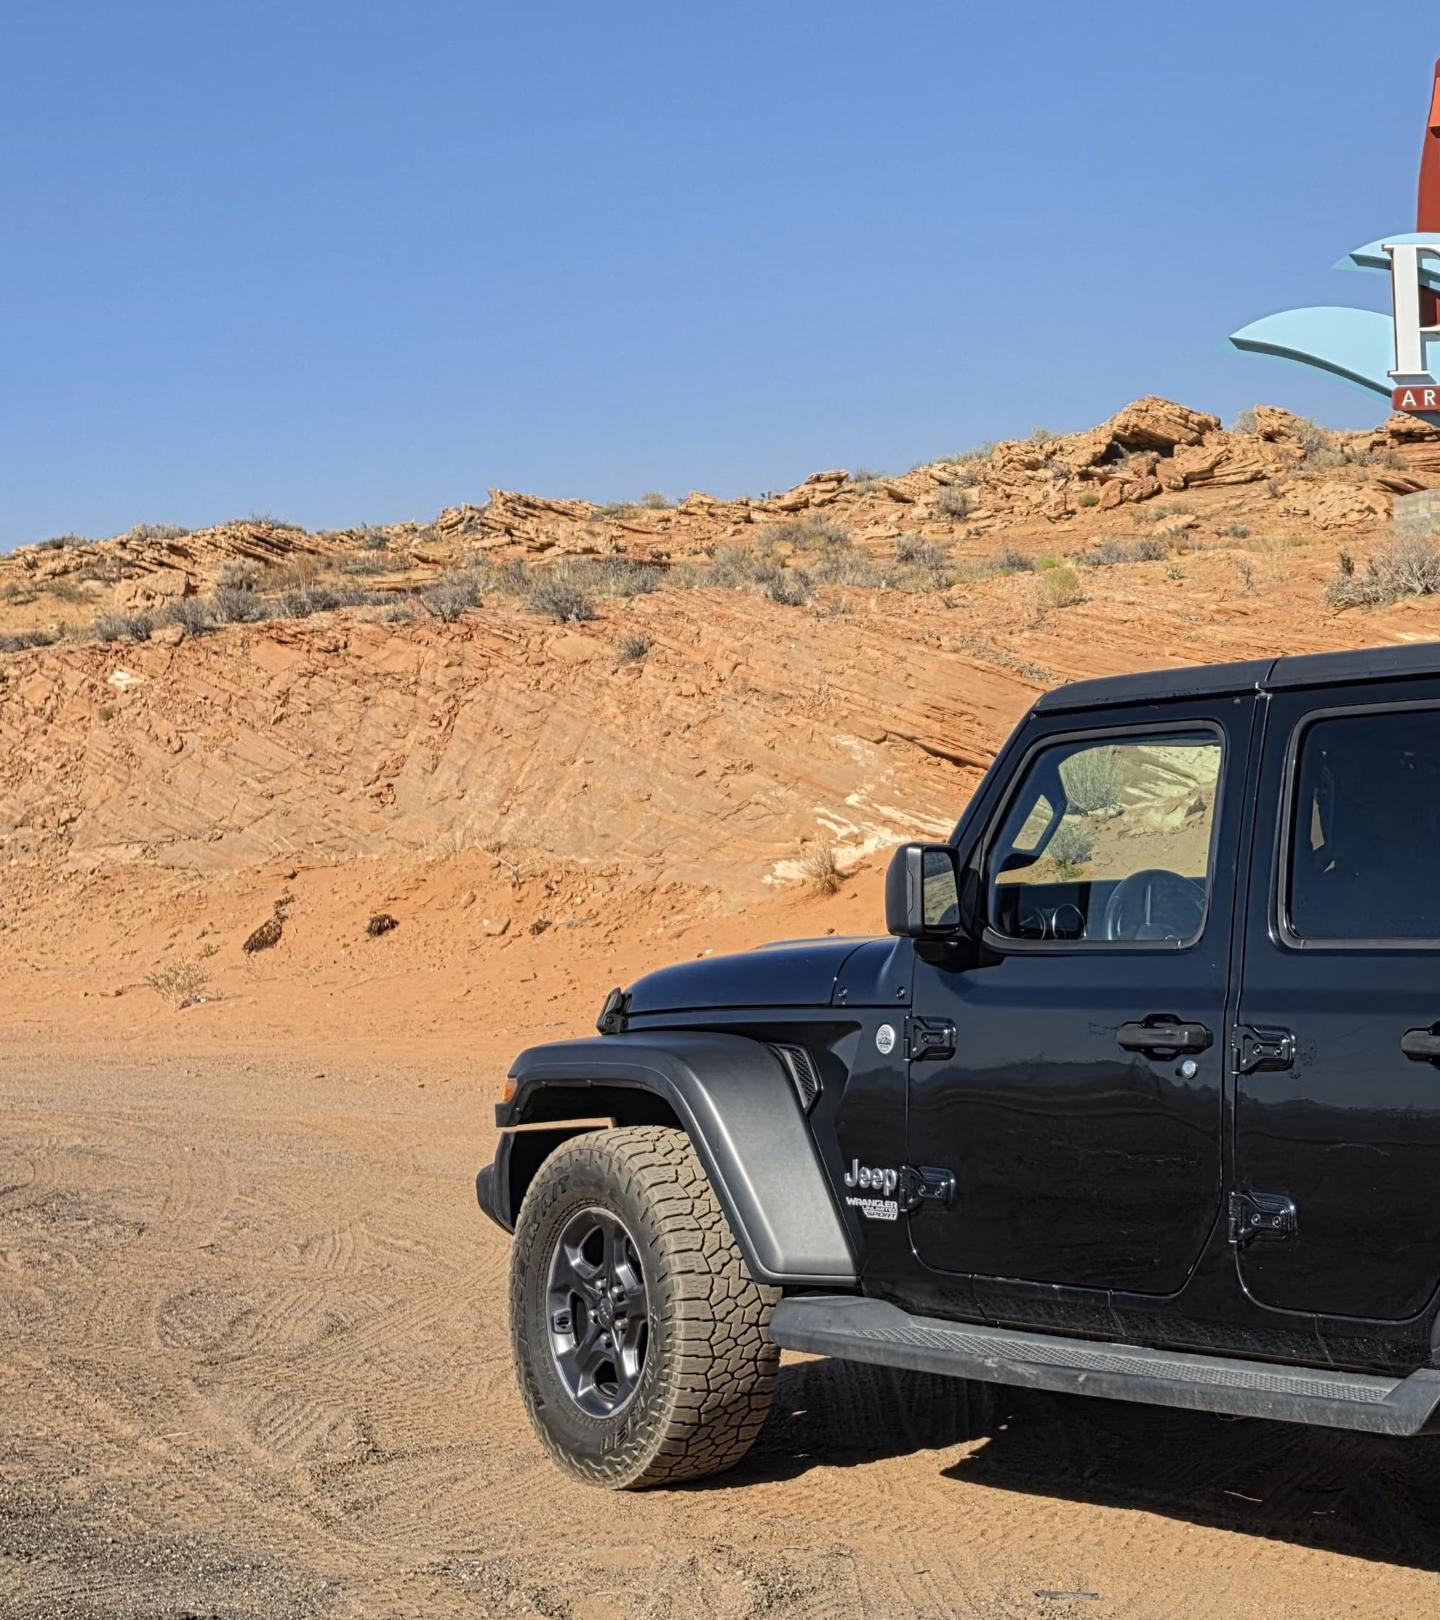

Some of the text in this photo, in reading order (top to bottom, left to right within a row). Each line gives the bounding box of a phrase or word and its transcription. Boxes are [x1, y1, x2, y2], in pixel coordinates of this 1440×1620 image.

[844, 1159, 898, 1196] Jeep
[845, 1196, 898, 1209] WRANGLER
[866, 1211, 896, 1219] SPORT
